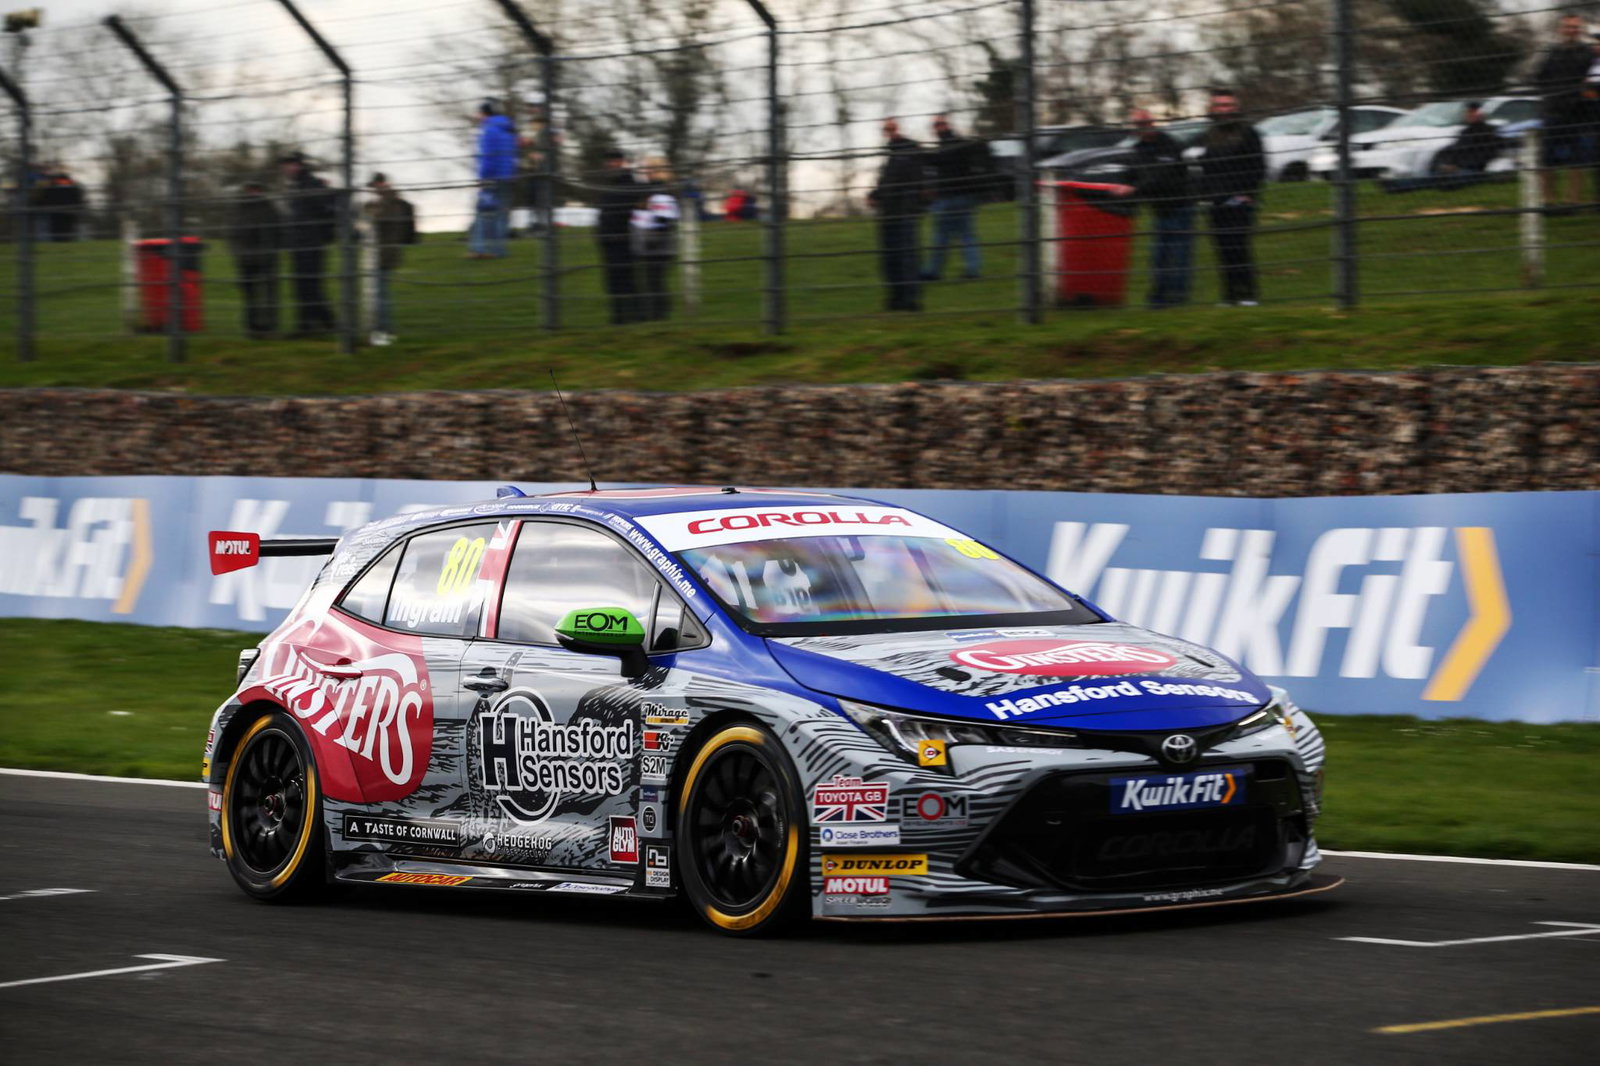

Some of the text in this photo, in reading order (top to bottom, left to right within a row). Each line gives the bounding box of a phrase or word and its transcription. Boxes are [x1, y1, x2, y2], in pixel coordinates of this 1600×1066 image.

[687, 511, 912, 535] COROLLA
[215, 540, 251, 555] MOTUL
[437, 537, 485, 595] 80
[629, 528, 697, 599] www.graphix.me
[390, 601, 464, 628] Ingram
[574, 612, 628, 632] EOM
[986, 680, 1262, 720] Hansford Sensors
[644, 703, 688, 721] Mirage
[519, 720, 632, 756] Hansford
[642, 757, 666, 774] S2M
[522, 756, 622, 794] Sensors
[834, 776, 861, 787] Team
[818, 791, 882, 802] TOYOTA GB
[1121, 774, 1225, 810] KwikFit
[904, 793, 967, 820] EOM
[350, 822, 456, 841] A TASTE OF CORNWALL
[614, 827, 634, 840] AUTO
[835, 830, 898, 839] Close Brothers
[497, 833, 552, 850] HEDGEHOG
[613, 839, 635, 853] GLYM
[840, 860, 923, 870] DUNLOP
[381, 873, 467, 886] AUTOCAR
[826, 878, 889, 892] MOTUL
